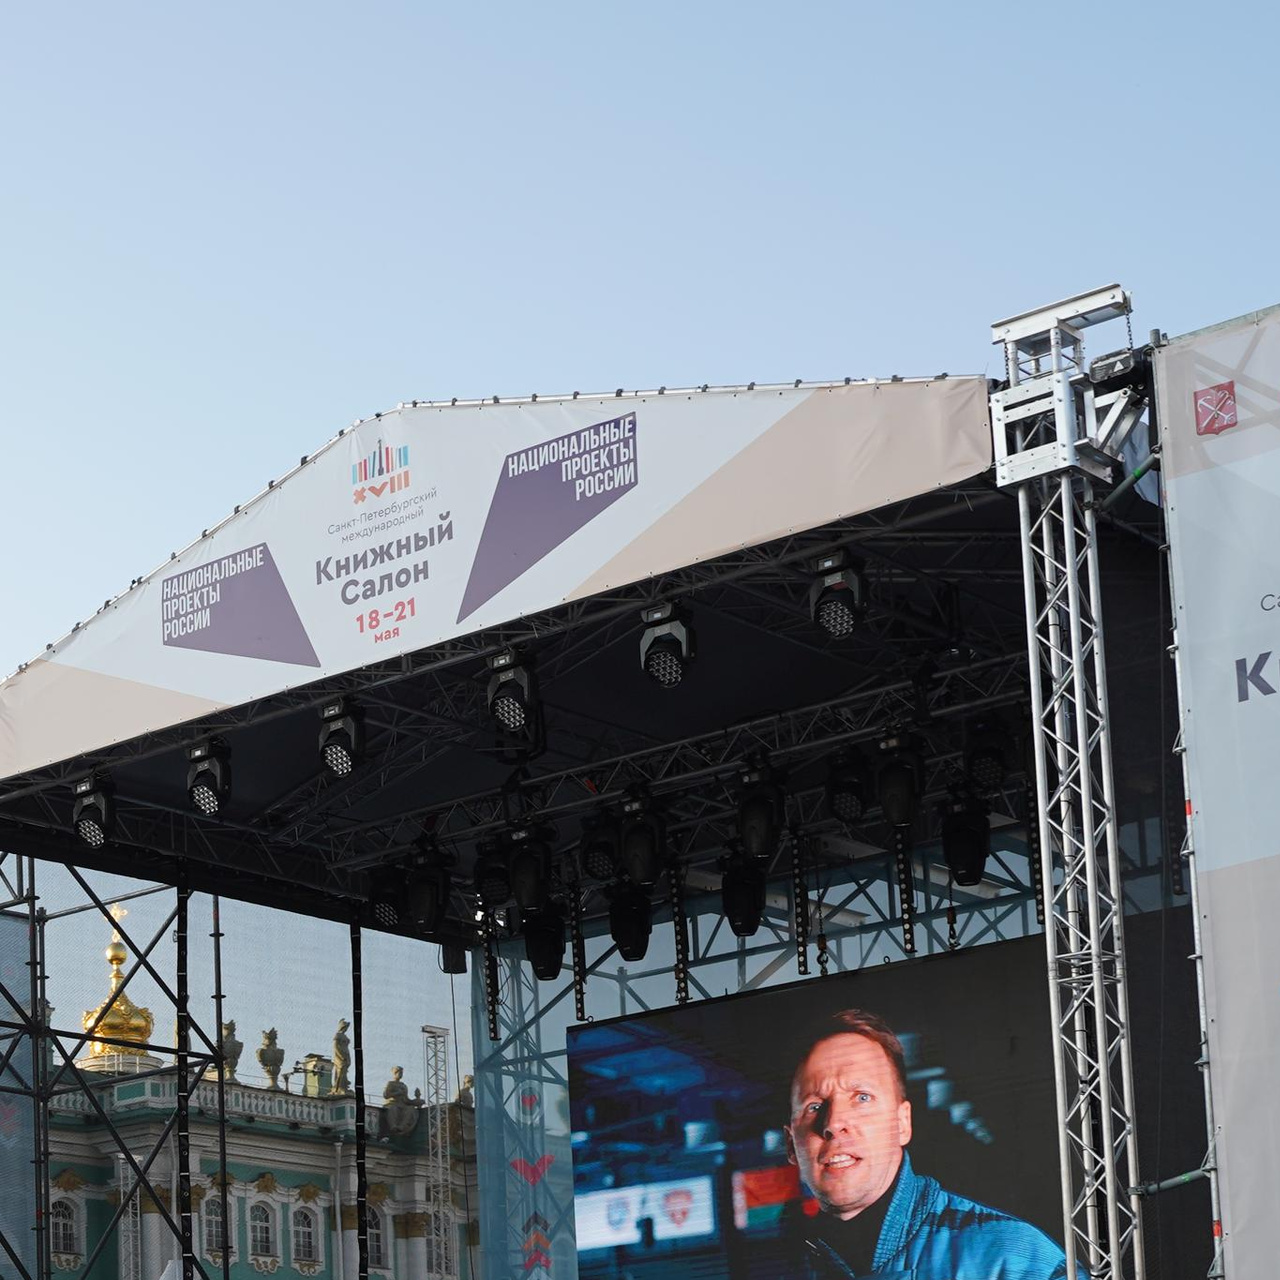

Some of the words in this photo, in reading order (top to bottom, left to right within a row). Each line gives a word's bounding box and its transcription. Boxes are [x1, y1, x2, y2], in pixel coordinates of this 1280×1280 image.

[507, 416, 634, 478] НАЦИОНАЛЬНЫЕ
[561, 441, 634, 482] ПРОЕКТЫ
[575, 463, 635, 501] РОССИИ
[327, 487, 437, 535] Санкт-Петербургский
[341, 507, 424, 544] международный
[316, 511, 454, 585] Книжный
[163, 546, 265, 598] НАЦИОНАЛЬНЫЕ
[340, 560, 430, 607] Салон
[163, 584, 220, 621] ПРОЕКТЫ
[163, 608, 211, 642] РОССИИ
[374, 626, 401, 645] мая
